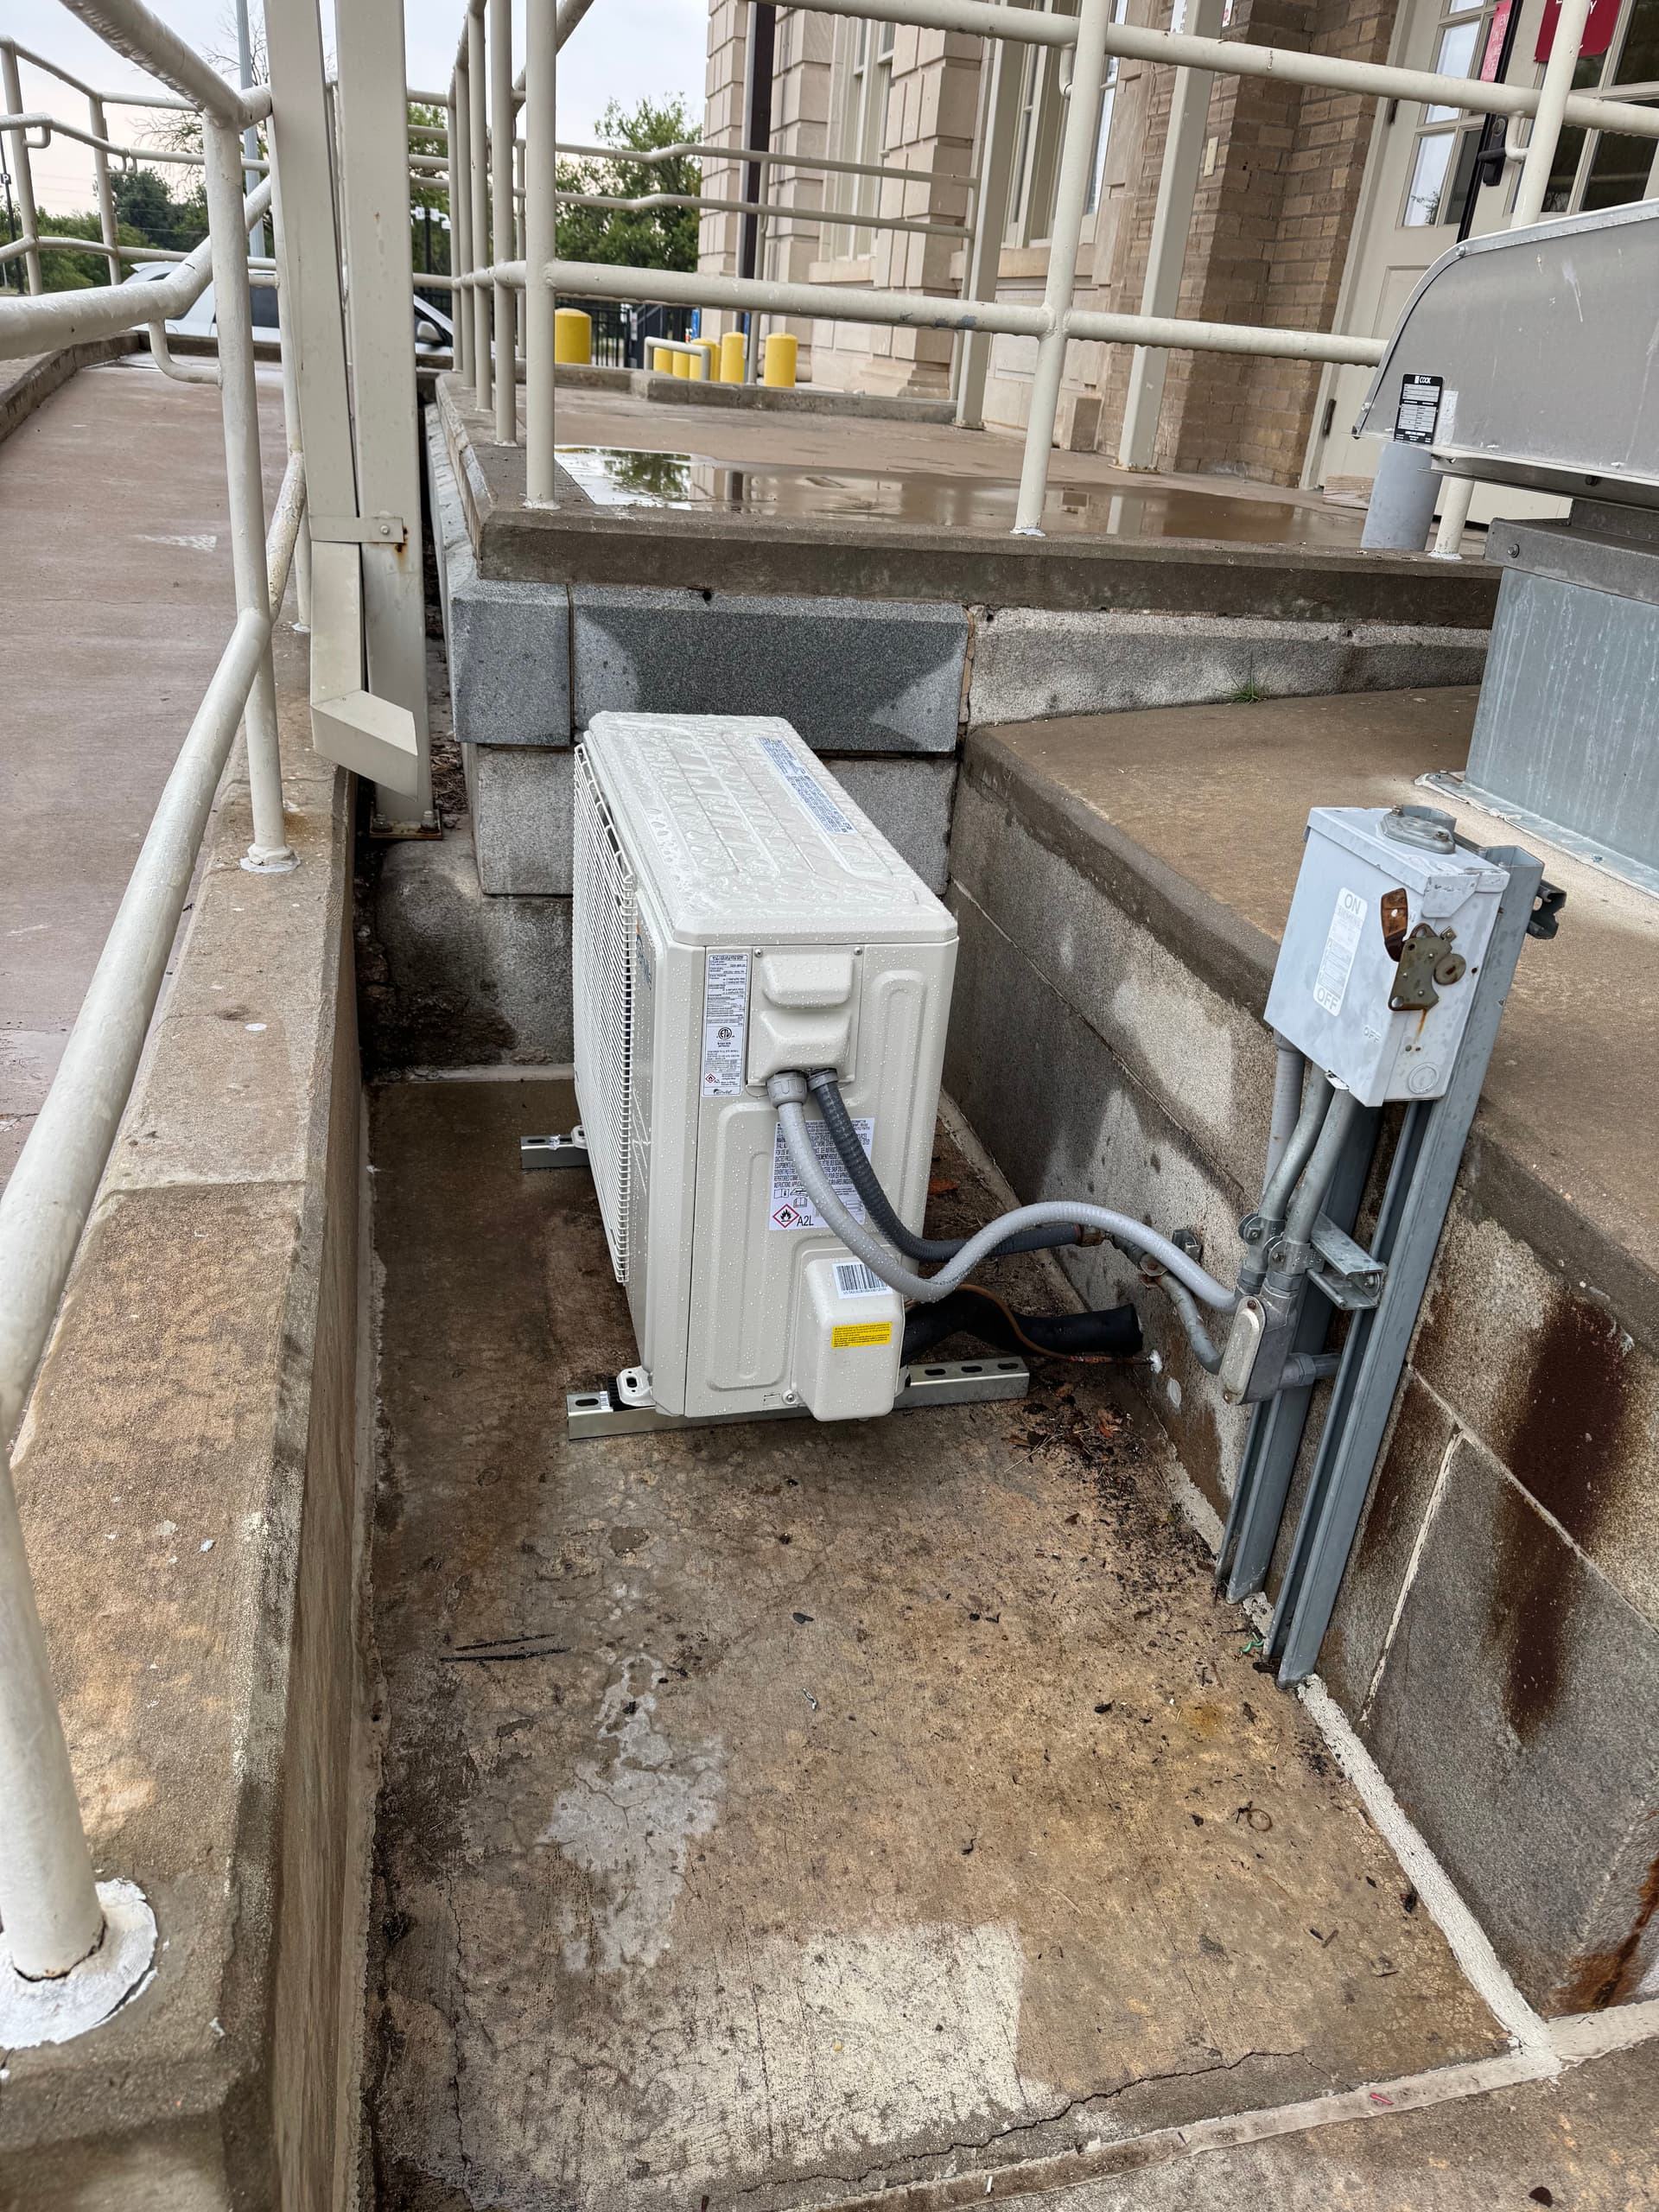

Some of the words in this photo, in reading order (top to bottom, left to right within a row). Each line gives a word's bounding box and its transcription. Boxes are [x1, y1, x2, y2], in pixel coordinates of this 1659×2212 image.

[1344, 893, 1362, 915] ON
[1318, 988, 1339, 1010] OFF
[1363, 1026, 1381, 1044] OFF
[797, 1215, 814, 1226] A2L
